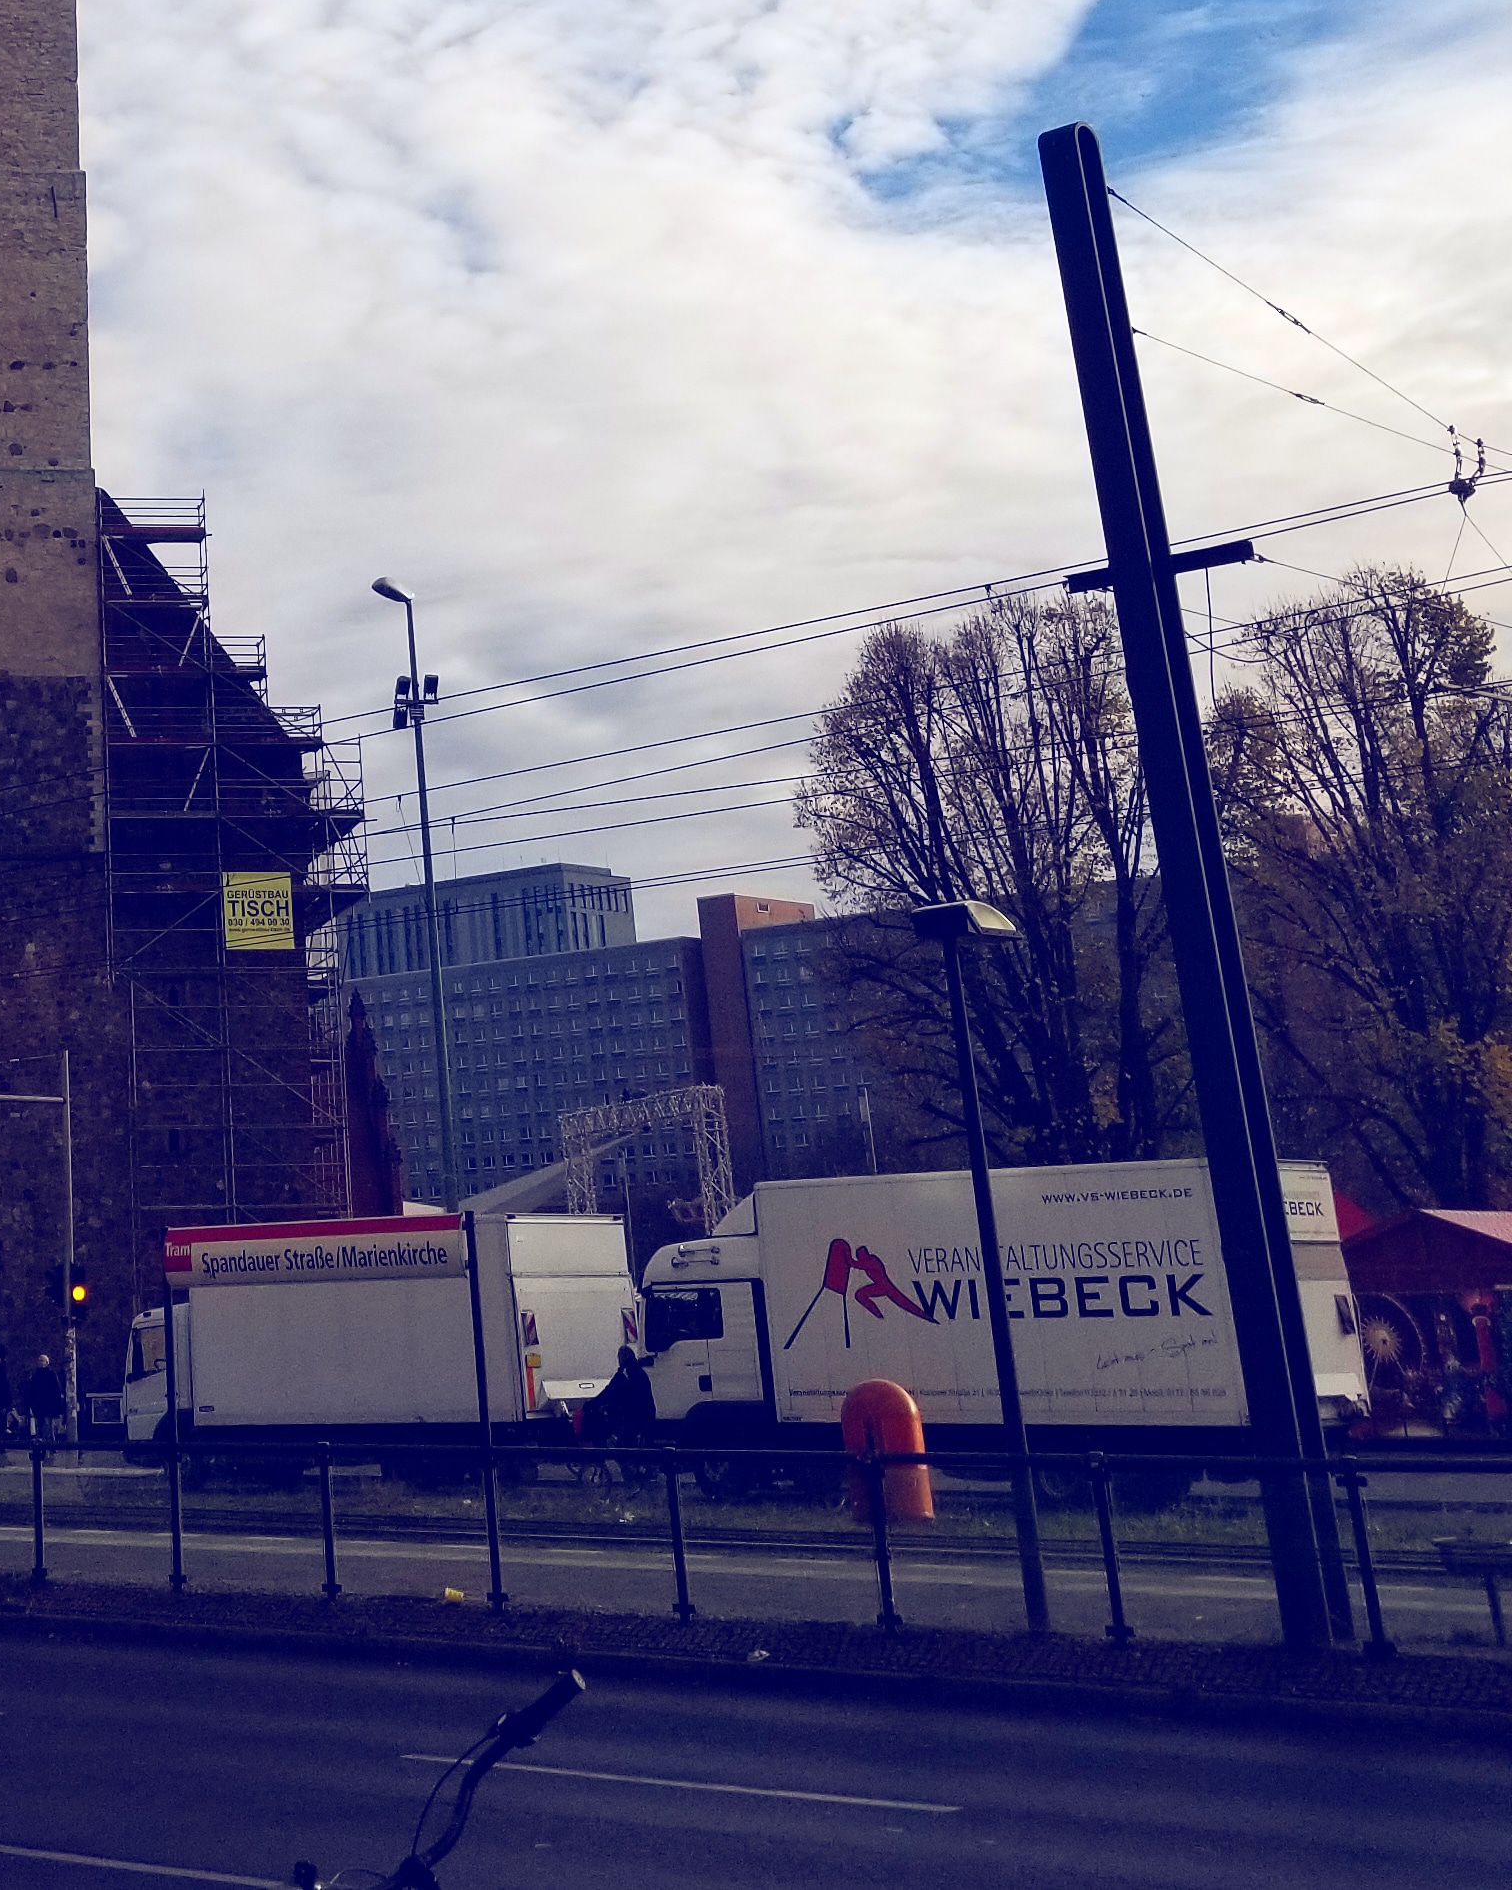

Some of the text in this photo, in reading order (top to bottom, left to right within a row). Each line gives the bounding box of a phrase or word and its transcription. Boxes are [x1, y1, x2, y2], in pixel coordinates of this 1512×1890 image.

[226, 888, 289, 899] GERÜSTBAU
[227, 899, 289, 917] TISCH
[228, 918, 243, 926] 030
[250, 918, 265, 926] 494
[267, 918, 278, 926] 00
[279, 918, 290, 926] 30
[1041, 1188, 1193, 1205] WWW.VS-WIEBECK.DE
[1282, 1201, 1324, 1216] BECK
[165, 1243, 190, 1257] Tram
[908, 1239, 1204, 1275] VERANALTUNGSSERVICE
[201, 1241, 448, 1278] Spandauer Straße/Marienkirche
